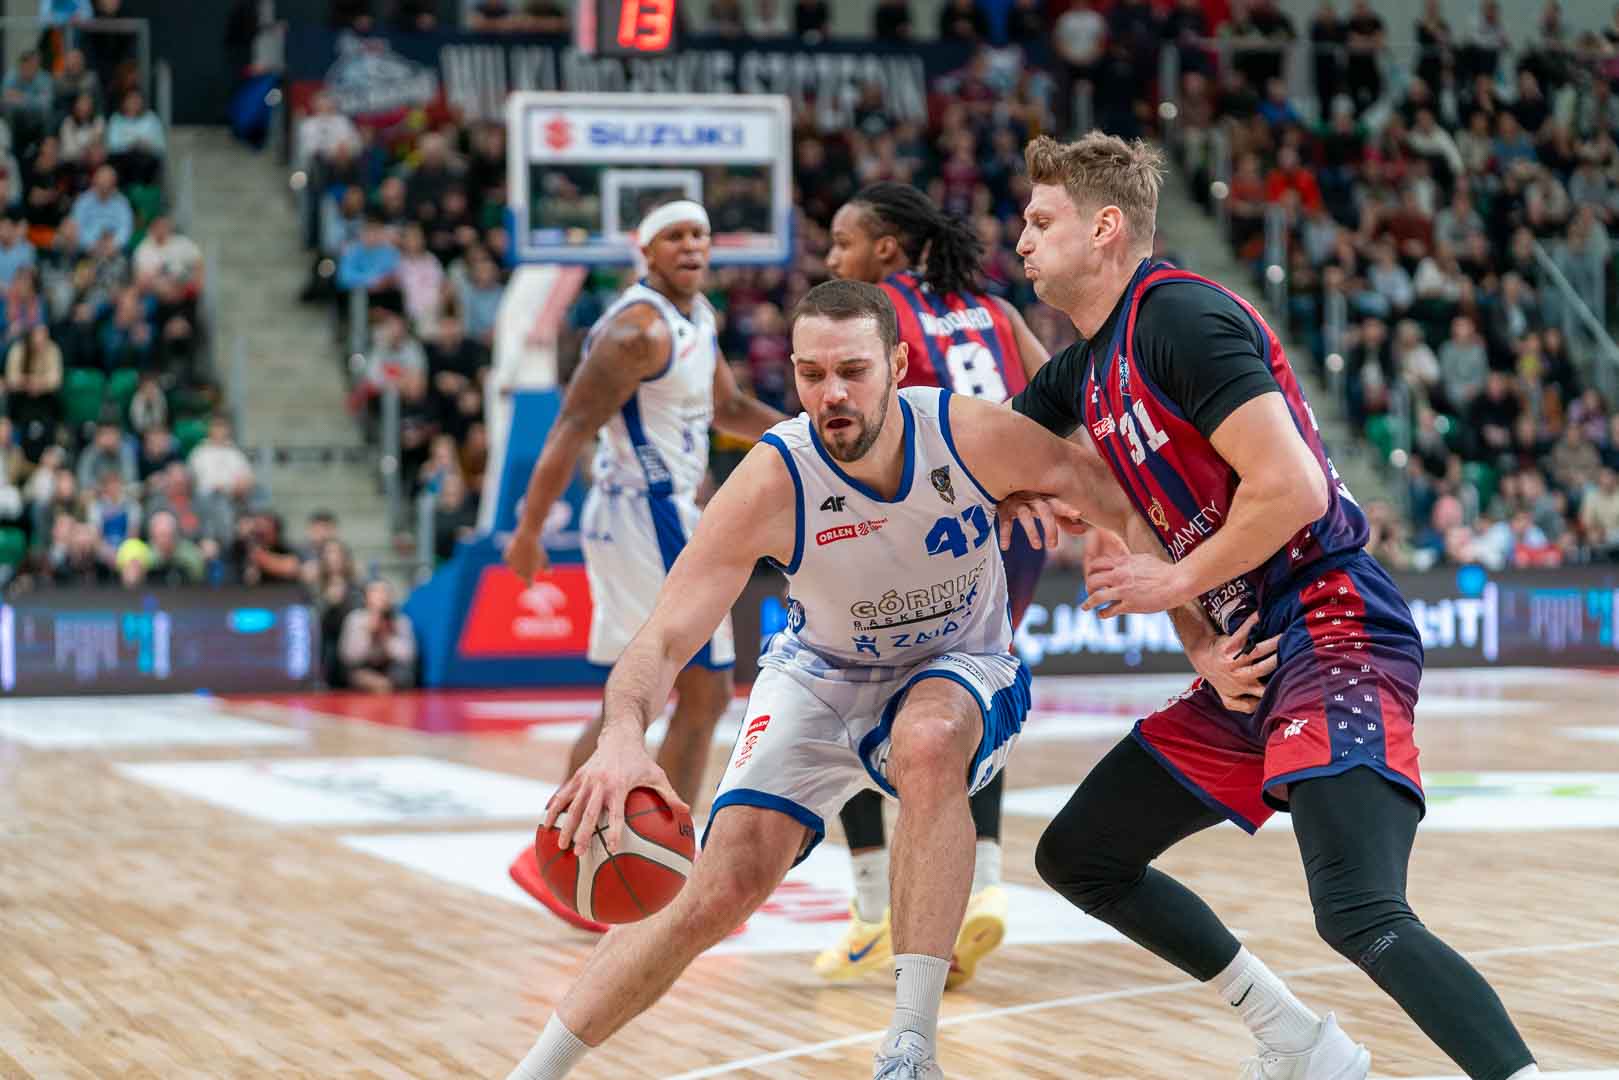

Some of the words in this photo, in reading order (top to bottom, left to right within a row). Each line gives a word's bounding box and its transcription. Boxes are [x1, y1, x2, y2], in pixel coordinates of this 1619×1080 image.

[617, 0, 674, 51] 13
[588, 120, 743, 146] SUZUKI
[946, 341, 1008, 404] 8
[1119, 399, 1170, 467] 31
[820, 496, 845, 512] 4F
[818, 527, 854, 544] ORLEN
[925, 504, 991, 558] 41
[850, 558, 986, 619] GÓRNIK
